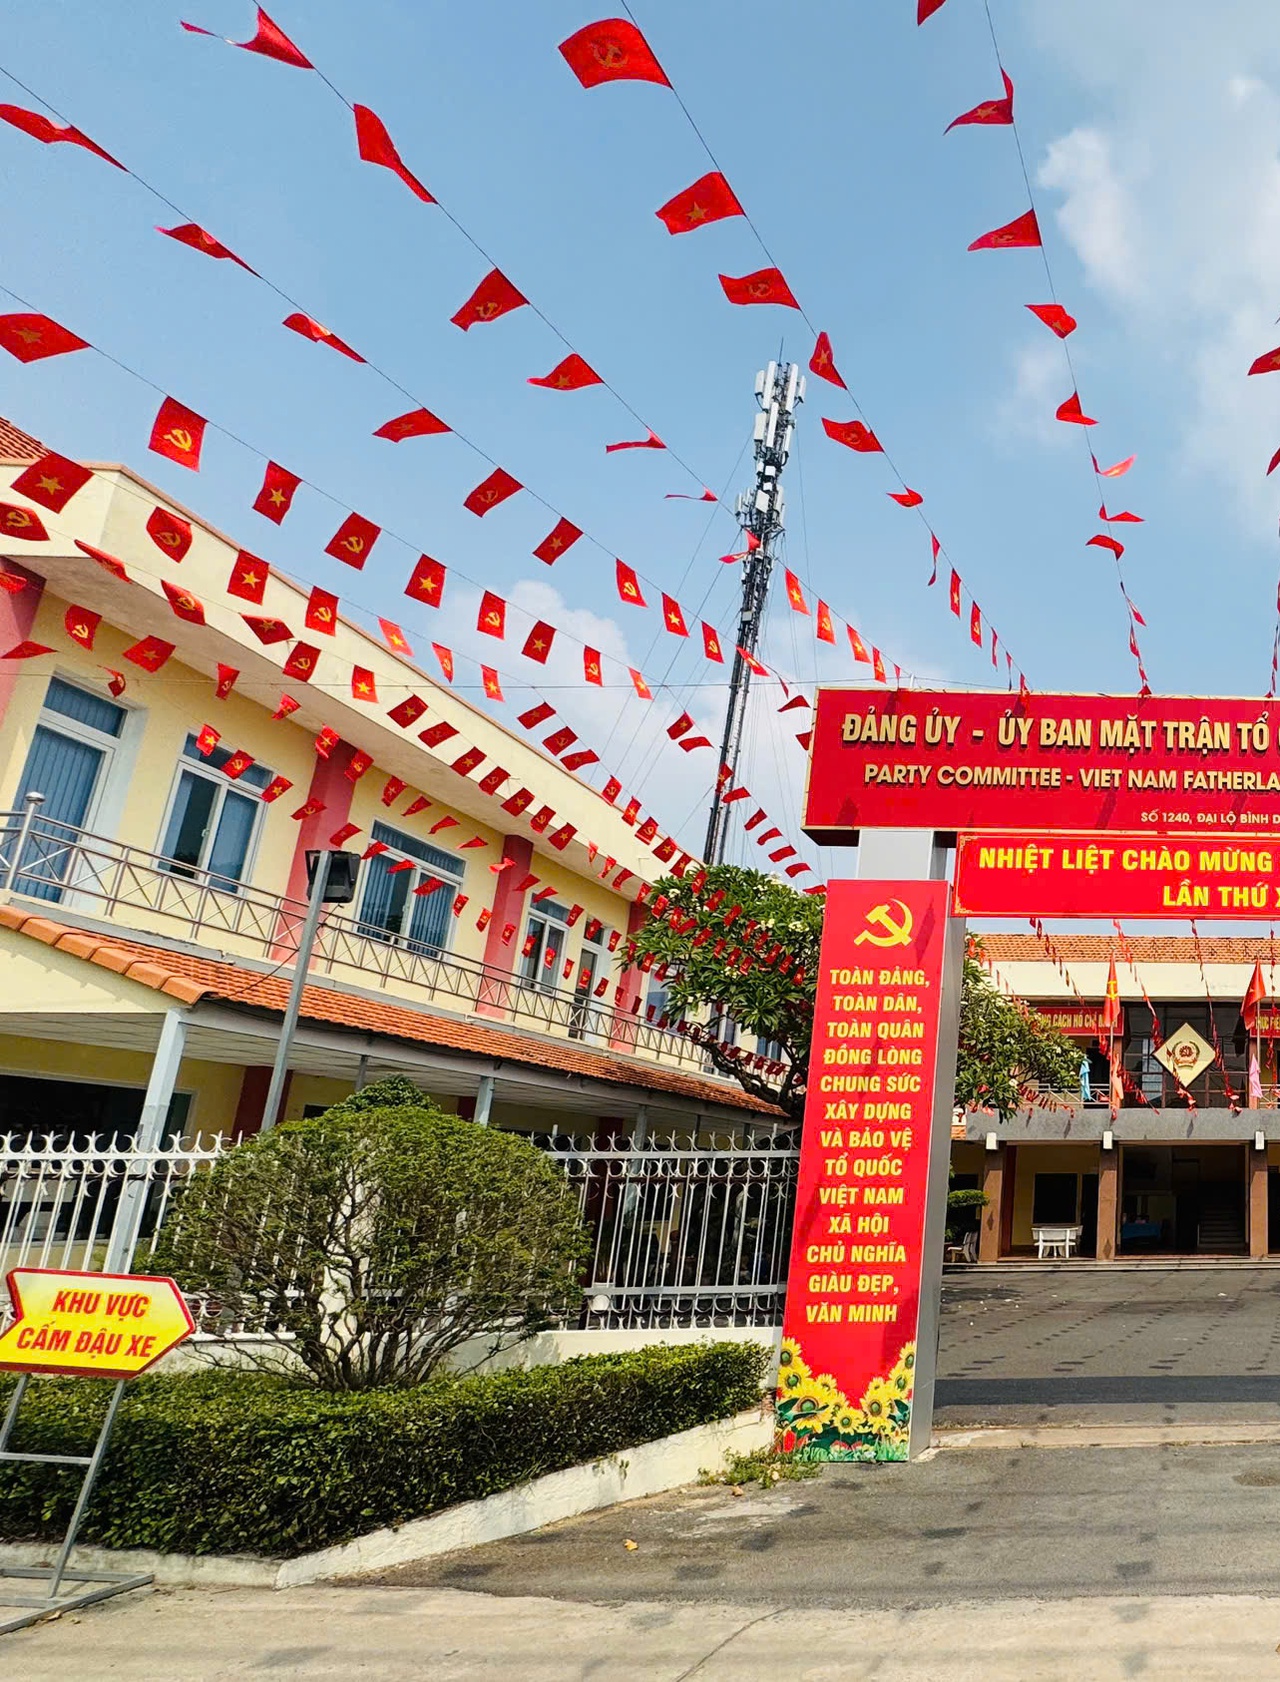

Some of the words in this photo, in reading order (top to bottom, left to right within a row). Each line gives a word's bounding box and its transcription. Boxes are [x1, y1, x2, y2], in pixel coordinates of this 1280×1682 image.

[842, 706, 917, 744] ĐẢNG
[925, 707, 961, 745] ỦY
[998, 709, 1033, 747] ỦY
[1040, 718, 1092, 748] BAN
[1101, 714, 1156, 755] MẶT
[1162, 717, 1230, 756] TRẬN
[1236, 712, 1270, 752] TỔ
[864, 764, 932, 785] PARTY
[937, 766, 1061, 787] COMMITTEE
[1080, 769, 1122, 788] VIET
[1128, 770, 1176, 789] NAM
[1141, 809, 1159, 823] SỐ
[1162, 812, 1193, 825] 1240,
[1197, 813, 1217, 826] ĐẠI
[1221, 811, 1237, 826] LỘ
[1240, 811, 1269, 824] BÌNH
[980, 843, 1054, 874] NHIỆT
[1062, 844, 1114, 875] LIỆT
[1122, 844, 1190, 871] CHÀO
[1200, 847, 1272, 873] MỪNG
[1163, 879, 1208, 906] LẦN
[1218, 883, 1266, 907] THỨ
[830, 969, 873, 985] TOÀN
[879, 967, 930, 988] ĐẢNG,
[833, 992, 877, 1011] TOÀN
[883, 994, 922, 1014] DÂN,
[827, 1019, 871, 1038] TOÀN
[877, 1020, 924, 1039] QUÂN
[824, 1043, 871, 1065] ĐỒNG
[877, 1046, 922, 1065] LÒNG
[820, 1076, 881, 1092] CHUNG
[886, 1072, 921, 1092] SỨC
[824, 1100, 858, 1119] XÂY
[863, 1103, 911, 1122] DỰNG
[820, 1127, 843, 1147] VÀ
[849, 1126, 884, 1147] BẢO
[890, 1128, 912, 1151] VỆ
[825, 1152, 848, 1176] TỔ
[853, 1153, 902, 1176] QUỐC
[819, 1184, 858, 1206] VIỆT
[863, 1188, 904, 1204] NAM
[828, 1213, 852, 1233] XÃ
[857, 1213, 889, 1235] HỘI
[806, 1239, 844, 1262] CHỦ
[851, 1240, 906, 1262] NGHĨA
[809, 1272, 851, 1293] GIÀU
[857, 1275, 899, 1296] ĐẸP,
[52, 1291, 101, 1315] KHU
[105, 1294, 149, 1321] VỰC
[806, 1301, 842, 1322] VĂN
[848, 1304, 897, 1322] MINH
[17, 1321, 71, 1351] CẤM
[74, 1328, 122, 1359] ĐẬU
[125, 1335, 157, 1357] XE
